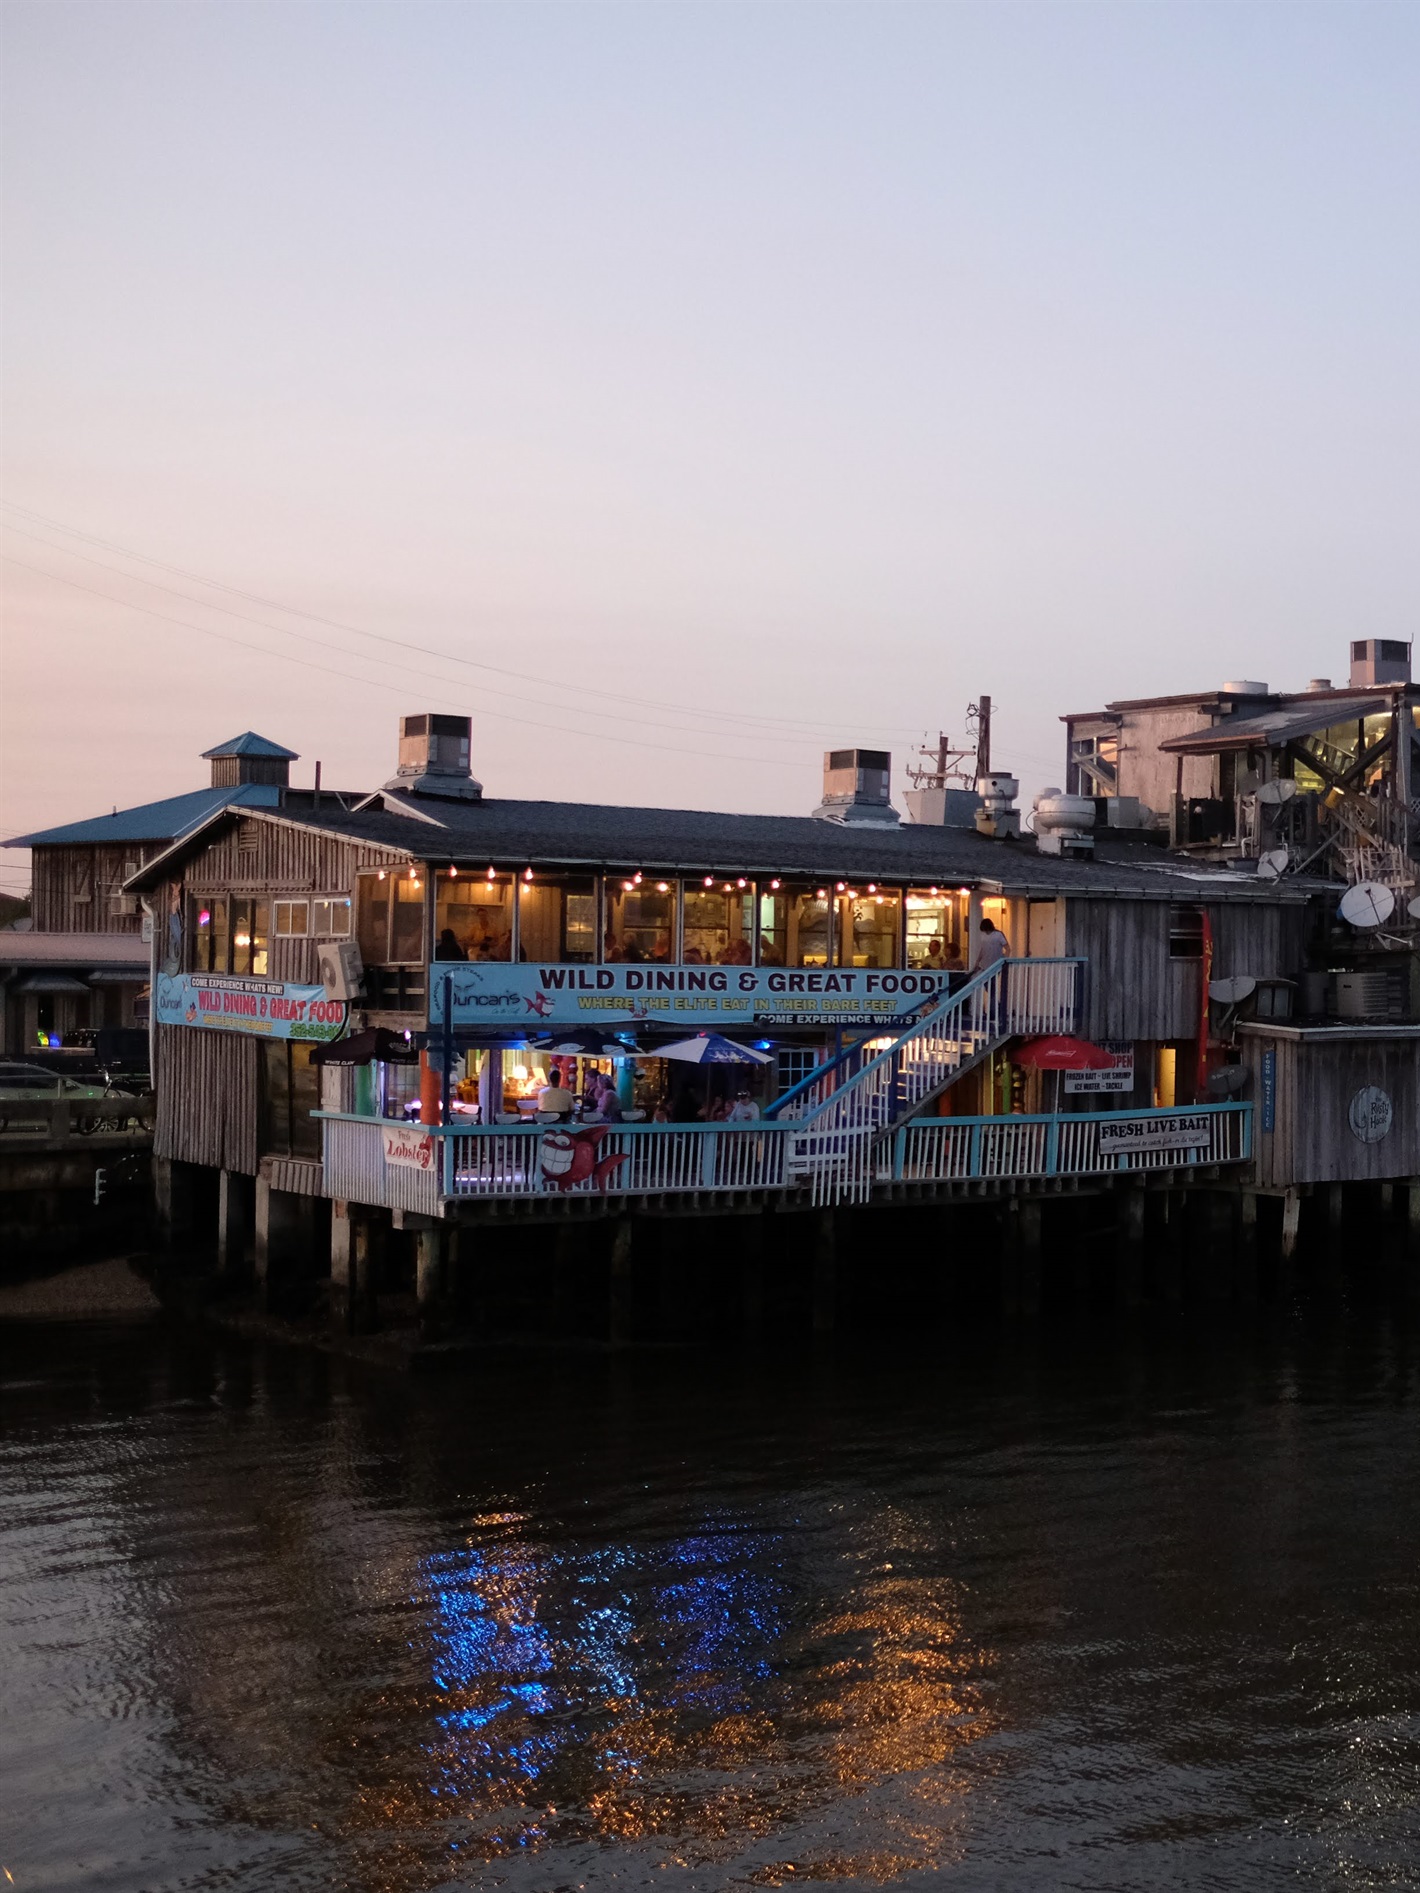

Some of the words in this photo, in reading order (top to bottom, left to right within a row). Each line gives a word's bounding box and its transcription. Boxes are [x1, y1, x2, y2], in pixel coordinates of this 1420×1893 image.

[191, 977, 207, 987] COME
[209, 979, 244, 990] EXPERIENCE
[267, 984, 283, 995] NEW!
[539, 969, 615, 990] WILD
[626, 970, 727, 991] DINING
[739, 972, 758, 992] &
[768, 974, 856, 993] GREAT
[866, 975, 943, 994] FOOD!
[198, 990, 221, 1012] WILD
[223, 992, 256, 1017] DINING
[259, 996, 268, 1018] &
[269, 998, 306, 1022] GREAT
[309, 1001, 343, 1024] FOOD
[578, 996, 634, 1010] WHERE
[639, 997, 671, 1010] THE
[674, 997, 717, 1010] ELITE
[721, 998, 750, 1011] EAT
[754, 998, 770, 1011] IN
[773, 999, 817, 1012] THEIR
[821, 1000, 859, 1012] BARE
[863, 1000, 897, 1012] FEET
[797, 1014, 871, 1024] EXPERIENCE
[1109, 1042, 1132, 1054] SHOP
[1113, 1055, 1132, 1068] PEN
[1264, 1053, 1272, 1075] FOOD
[1066, 1072, 1084, 1080] FROZEN
[1085, 1072, 1097, 1080] BAIT
[1102, 1071, 1111, 1079] LIVE
[1112, 1071, 1131, 1079] SHRIMP
[1106, 1082, 1123, 1090] TACKLE
[1264, 1079, 1272, 1107] WATER
[1101, 1123, 1143, 1139] FRESH
[1147, 1120, 1177, 1134] LIVE
[1179, 1116, 1208, 1131] BAIT
[387, 1139, 428, 1161] Lobster
